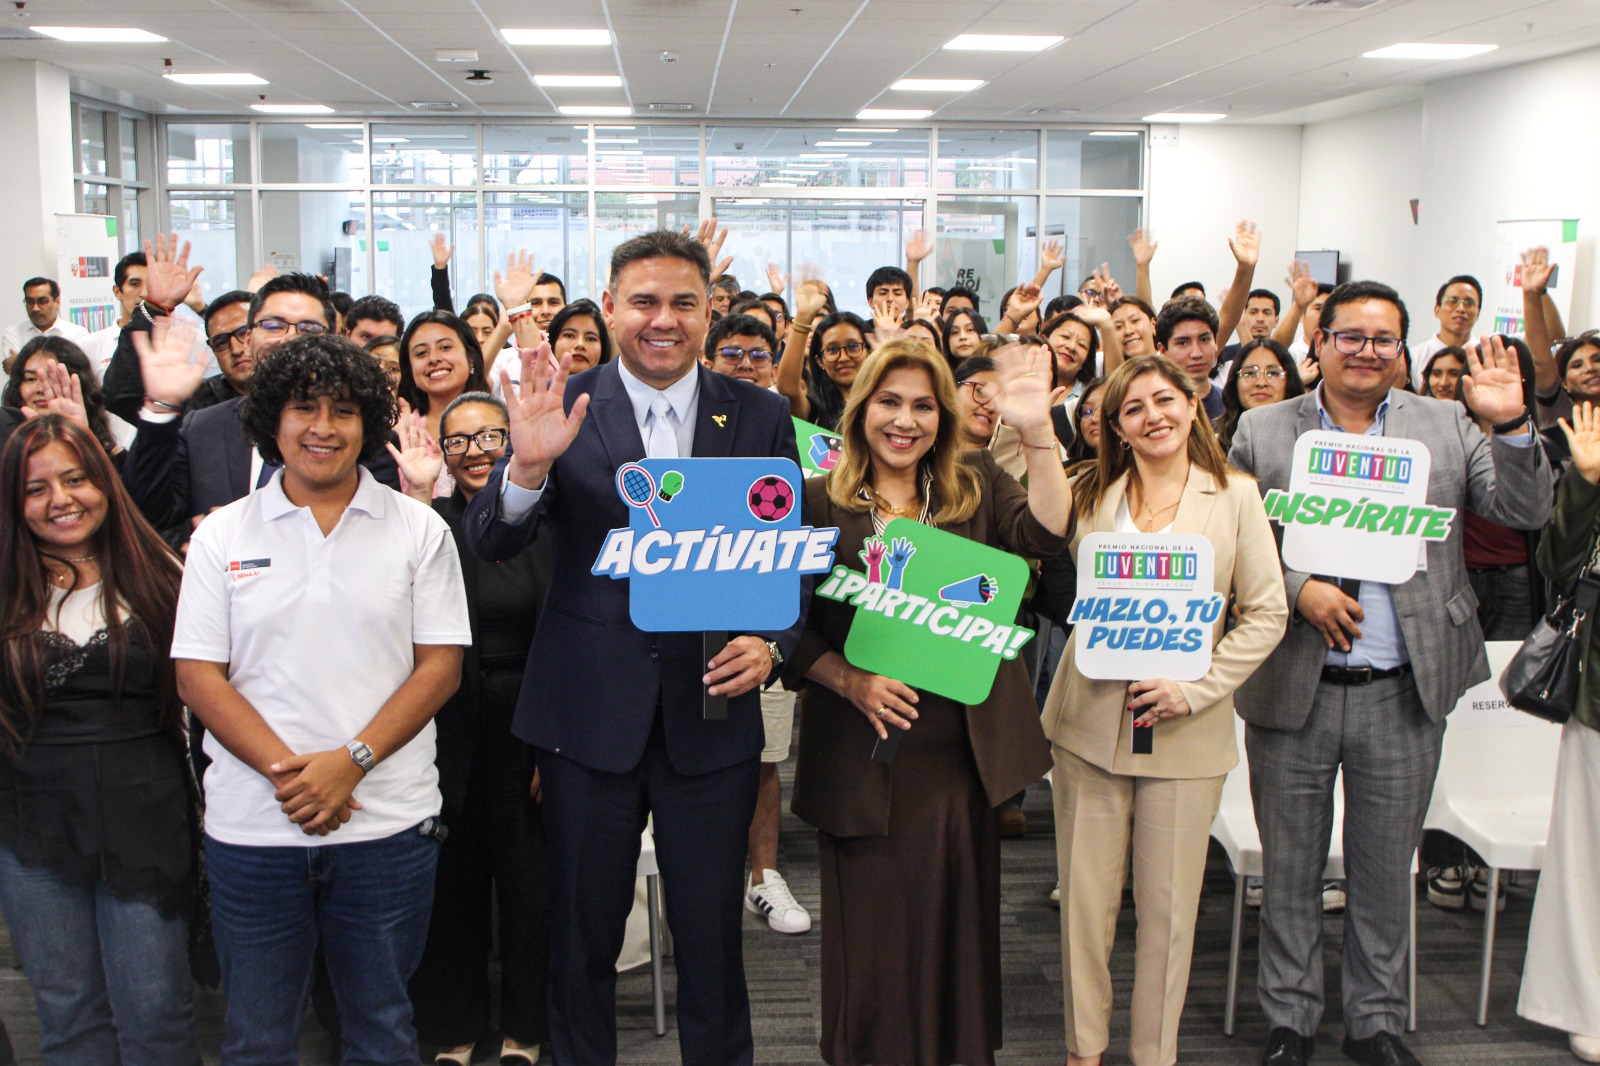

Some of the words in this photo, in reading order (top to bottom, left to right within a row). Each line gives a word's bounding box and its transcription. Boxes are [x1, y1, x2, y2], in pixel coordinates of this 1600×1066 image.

[957, 268, 974, 278] RE
[1314, 440, 1342, 448] PREMIO
[1345, 443, 1384, 453] NACIONAL
[1309, 449, 1411, 481] JUVENTUD
[1263, 492, 1455, 538] INSPÍRATE
[596, 525, 839, 576] ACTÍVATE
[1096, 554, 1196, 578] JUVENTUD
[818, 565, 1033, 660] ¡PARTICIPA!
[1071, 597, 1178, 625] HAZLO,
[1185, 595, 1223, 623] TÚ
[1086, 626, 1203, 653] PUEDES
